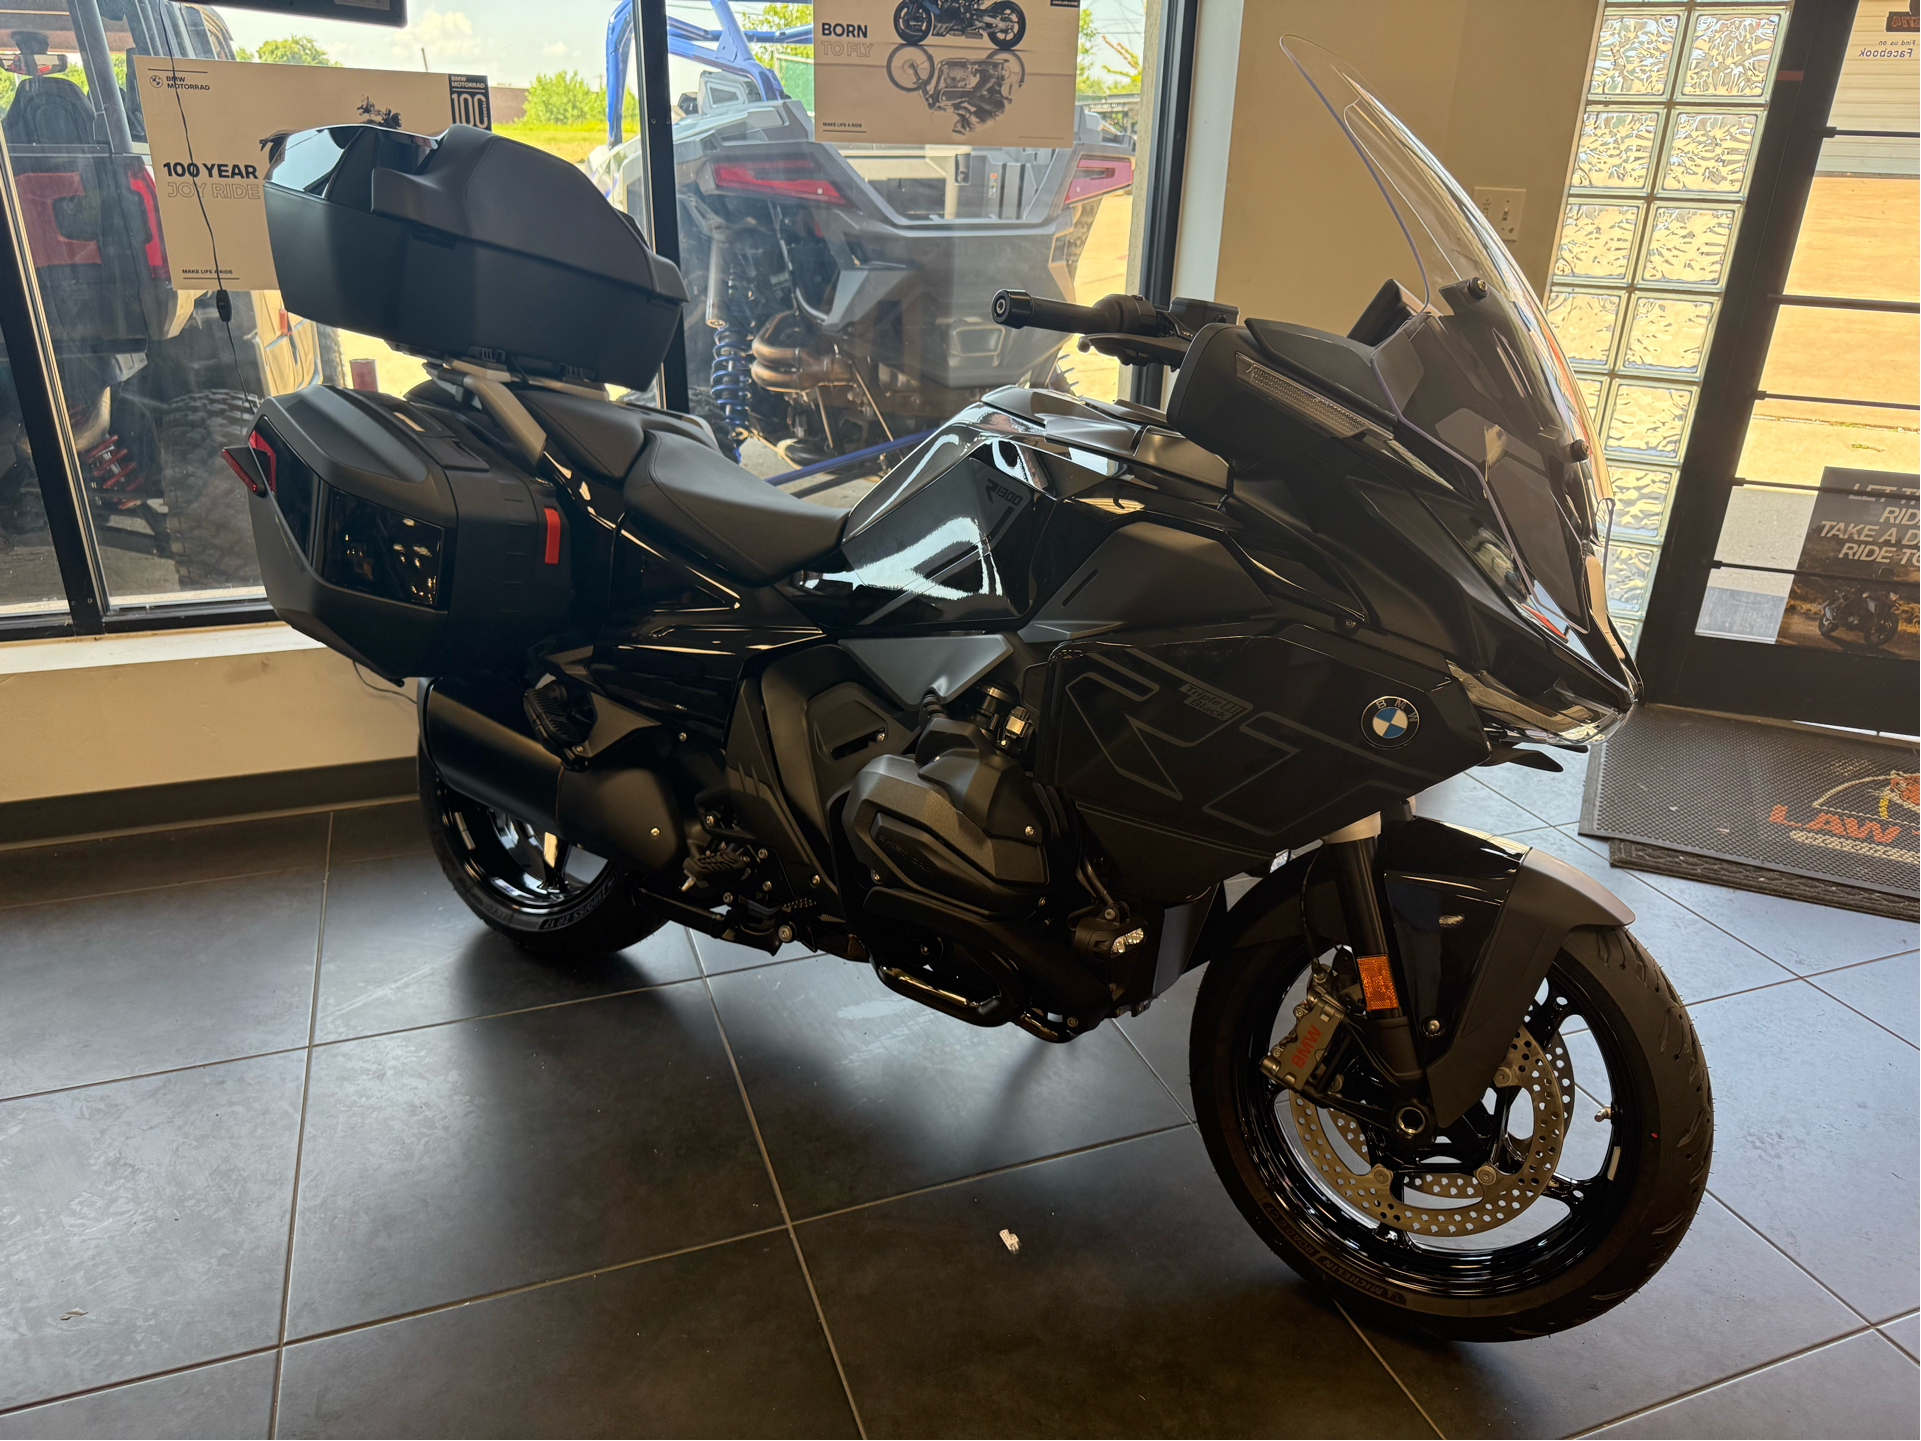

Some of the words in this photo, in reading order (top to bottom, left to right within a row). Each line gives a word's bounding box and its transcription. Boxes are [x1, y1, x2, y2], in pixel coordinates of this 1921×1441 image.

[821, 22, 868, 39] BORN
[820, 40, 845, 57] TO
[846, 42, 874, 58] FLY
[167, 82, 211, 91] MOTORRAD
[451, 81, 486, 89] MOTORRAD
[451, 93, 489, 129] 100
[163, 161, 200, 178] 100
[201, 163, 259, 179] YEAR
[167, 181, 207, 198] JOY
[211, 183, 261, 199] RIDE
[1819, 520, 1880, 542] TAKE
[1877, 527, 1898, 544] A
[1838, 542, 1897, 564] RIDE
[1186, 685, 1222, 706] Triple
[1189, 699, 1226, 720] Black
[1768, 803, 1902, 844] LAW
[1291, 1023, 1322, 1069] BMW
[1265, 1206, 1281, 1220] GT
[1286, 1228, 1314, 1256] ROAD
[1322, 1259, 1384, 1296] MICHELIN
